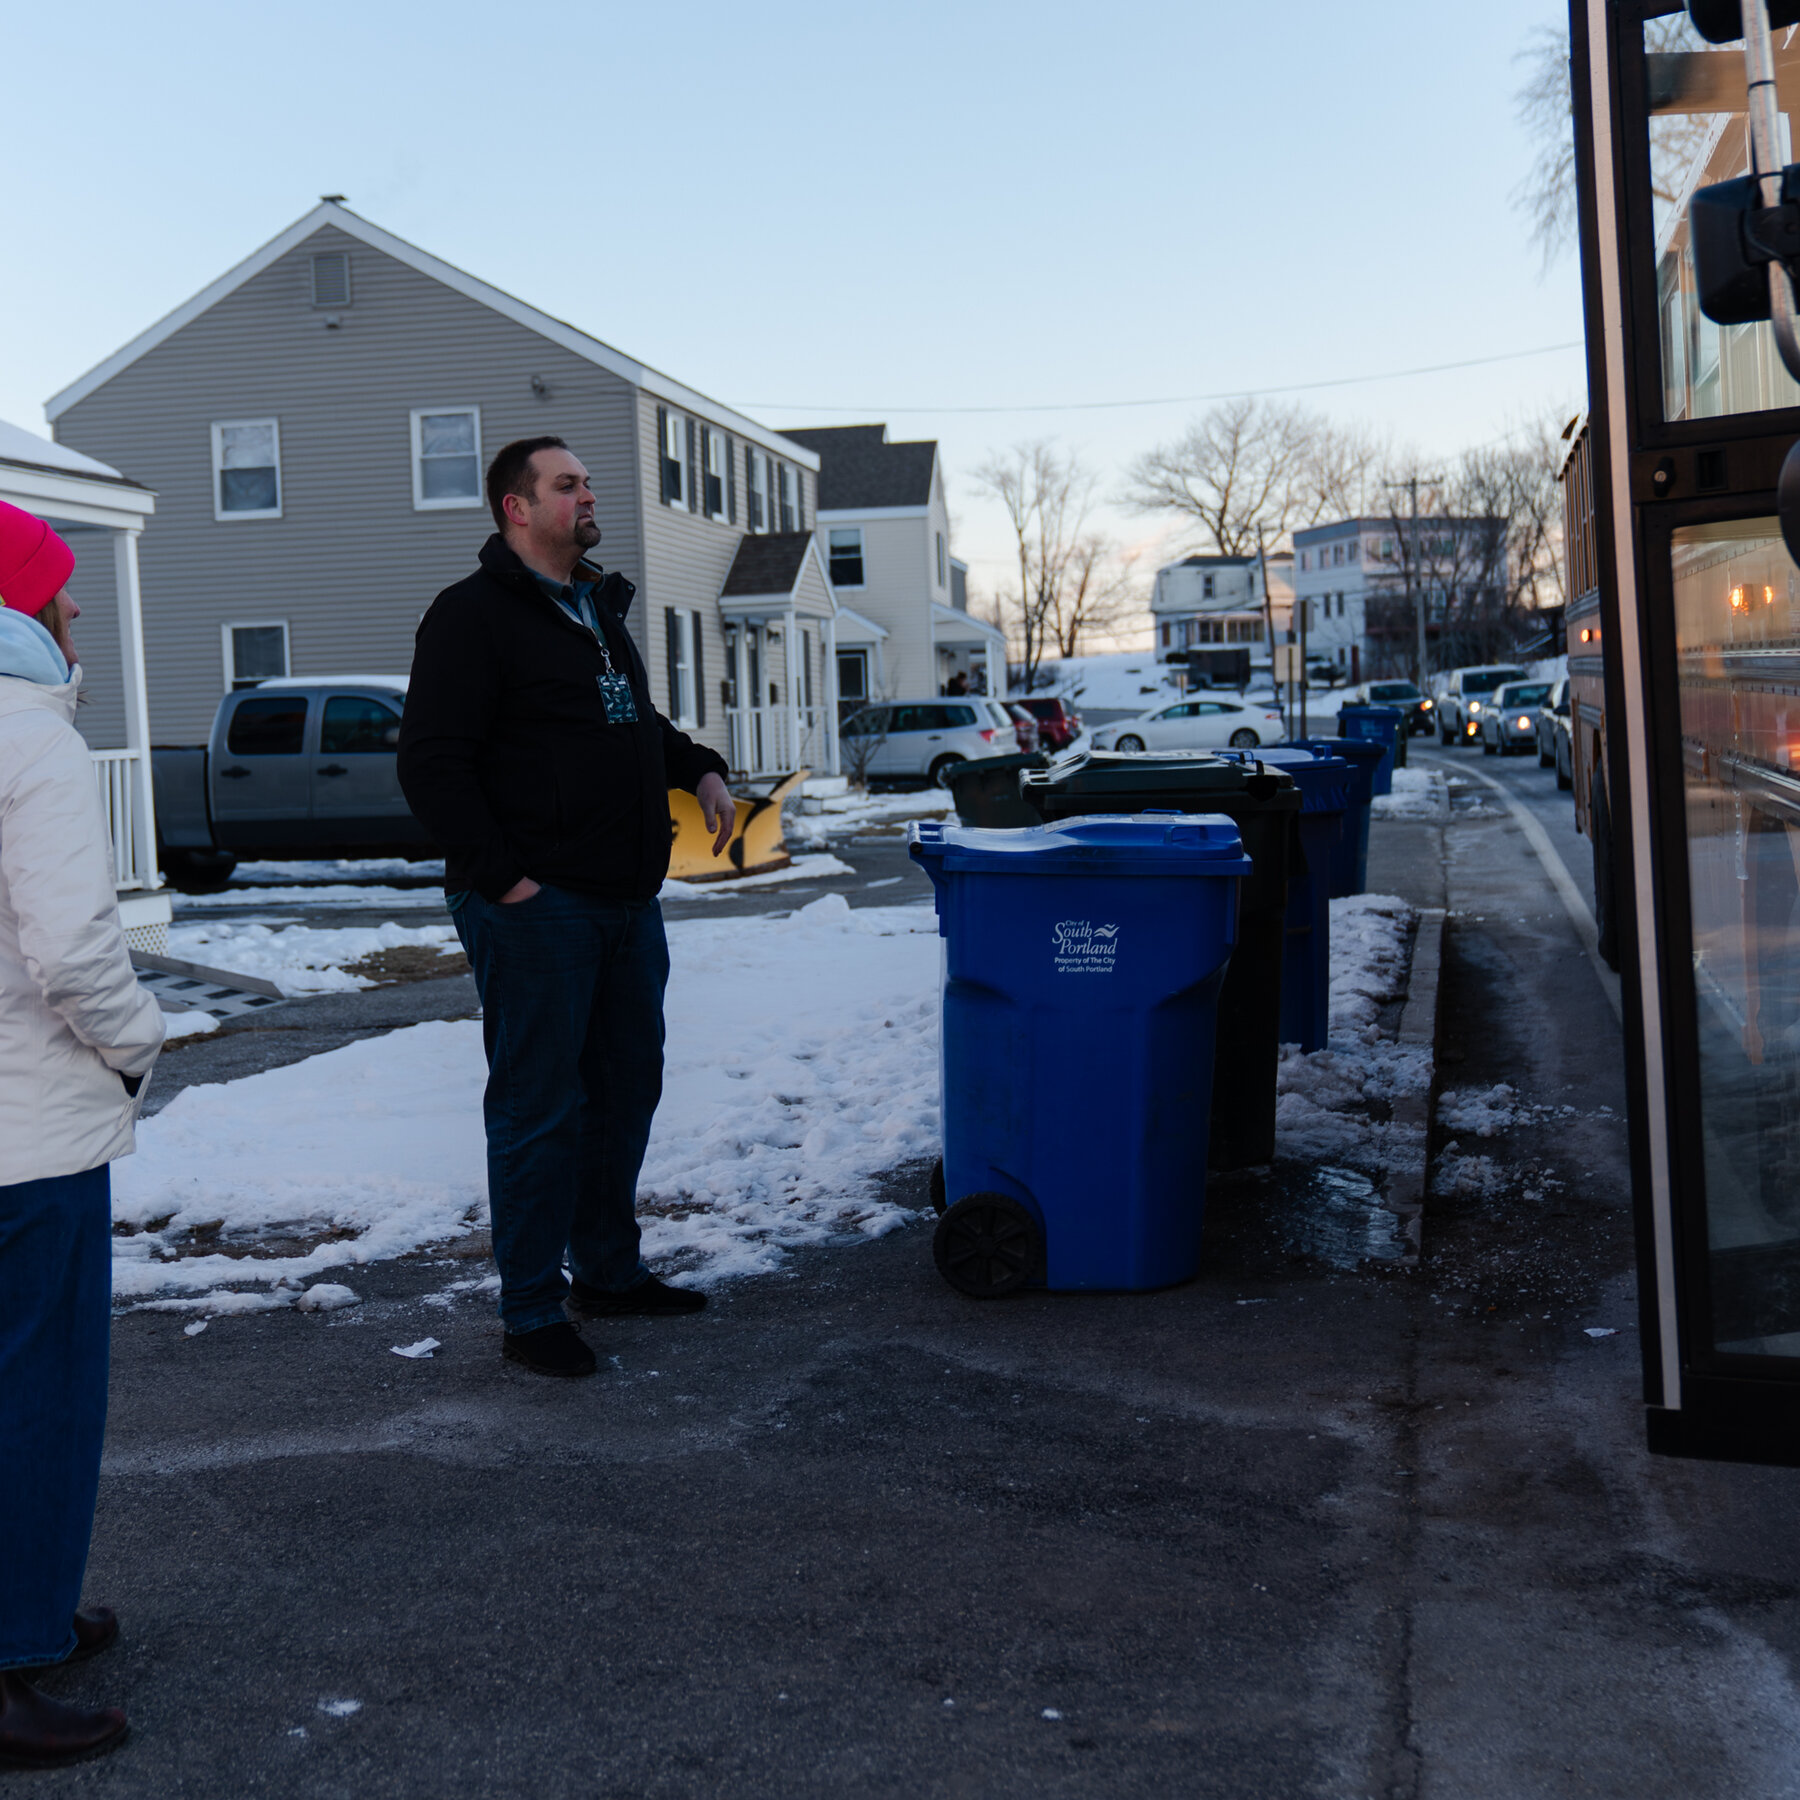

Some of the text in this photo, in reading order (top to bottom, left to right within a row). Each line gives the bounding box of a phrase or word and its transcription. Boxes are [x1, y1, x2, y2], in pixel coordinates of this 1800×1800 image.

[1065, 919, 1077, 927] City
[1052, 921, 1092, 944] South
[1059, 938, 1118, 954] Portland
[1054, 957, 1081, 965] Property
[1103, 957, 1116, 965] City
